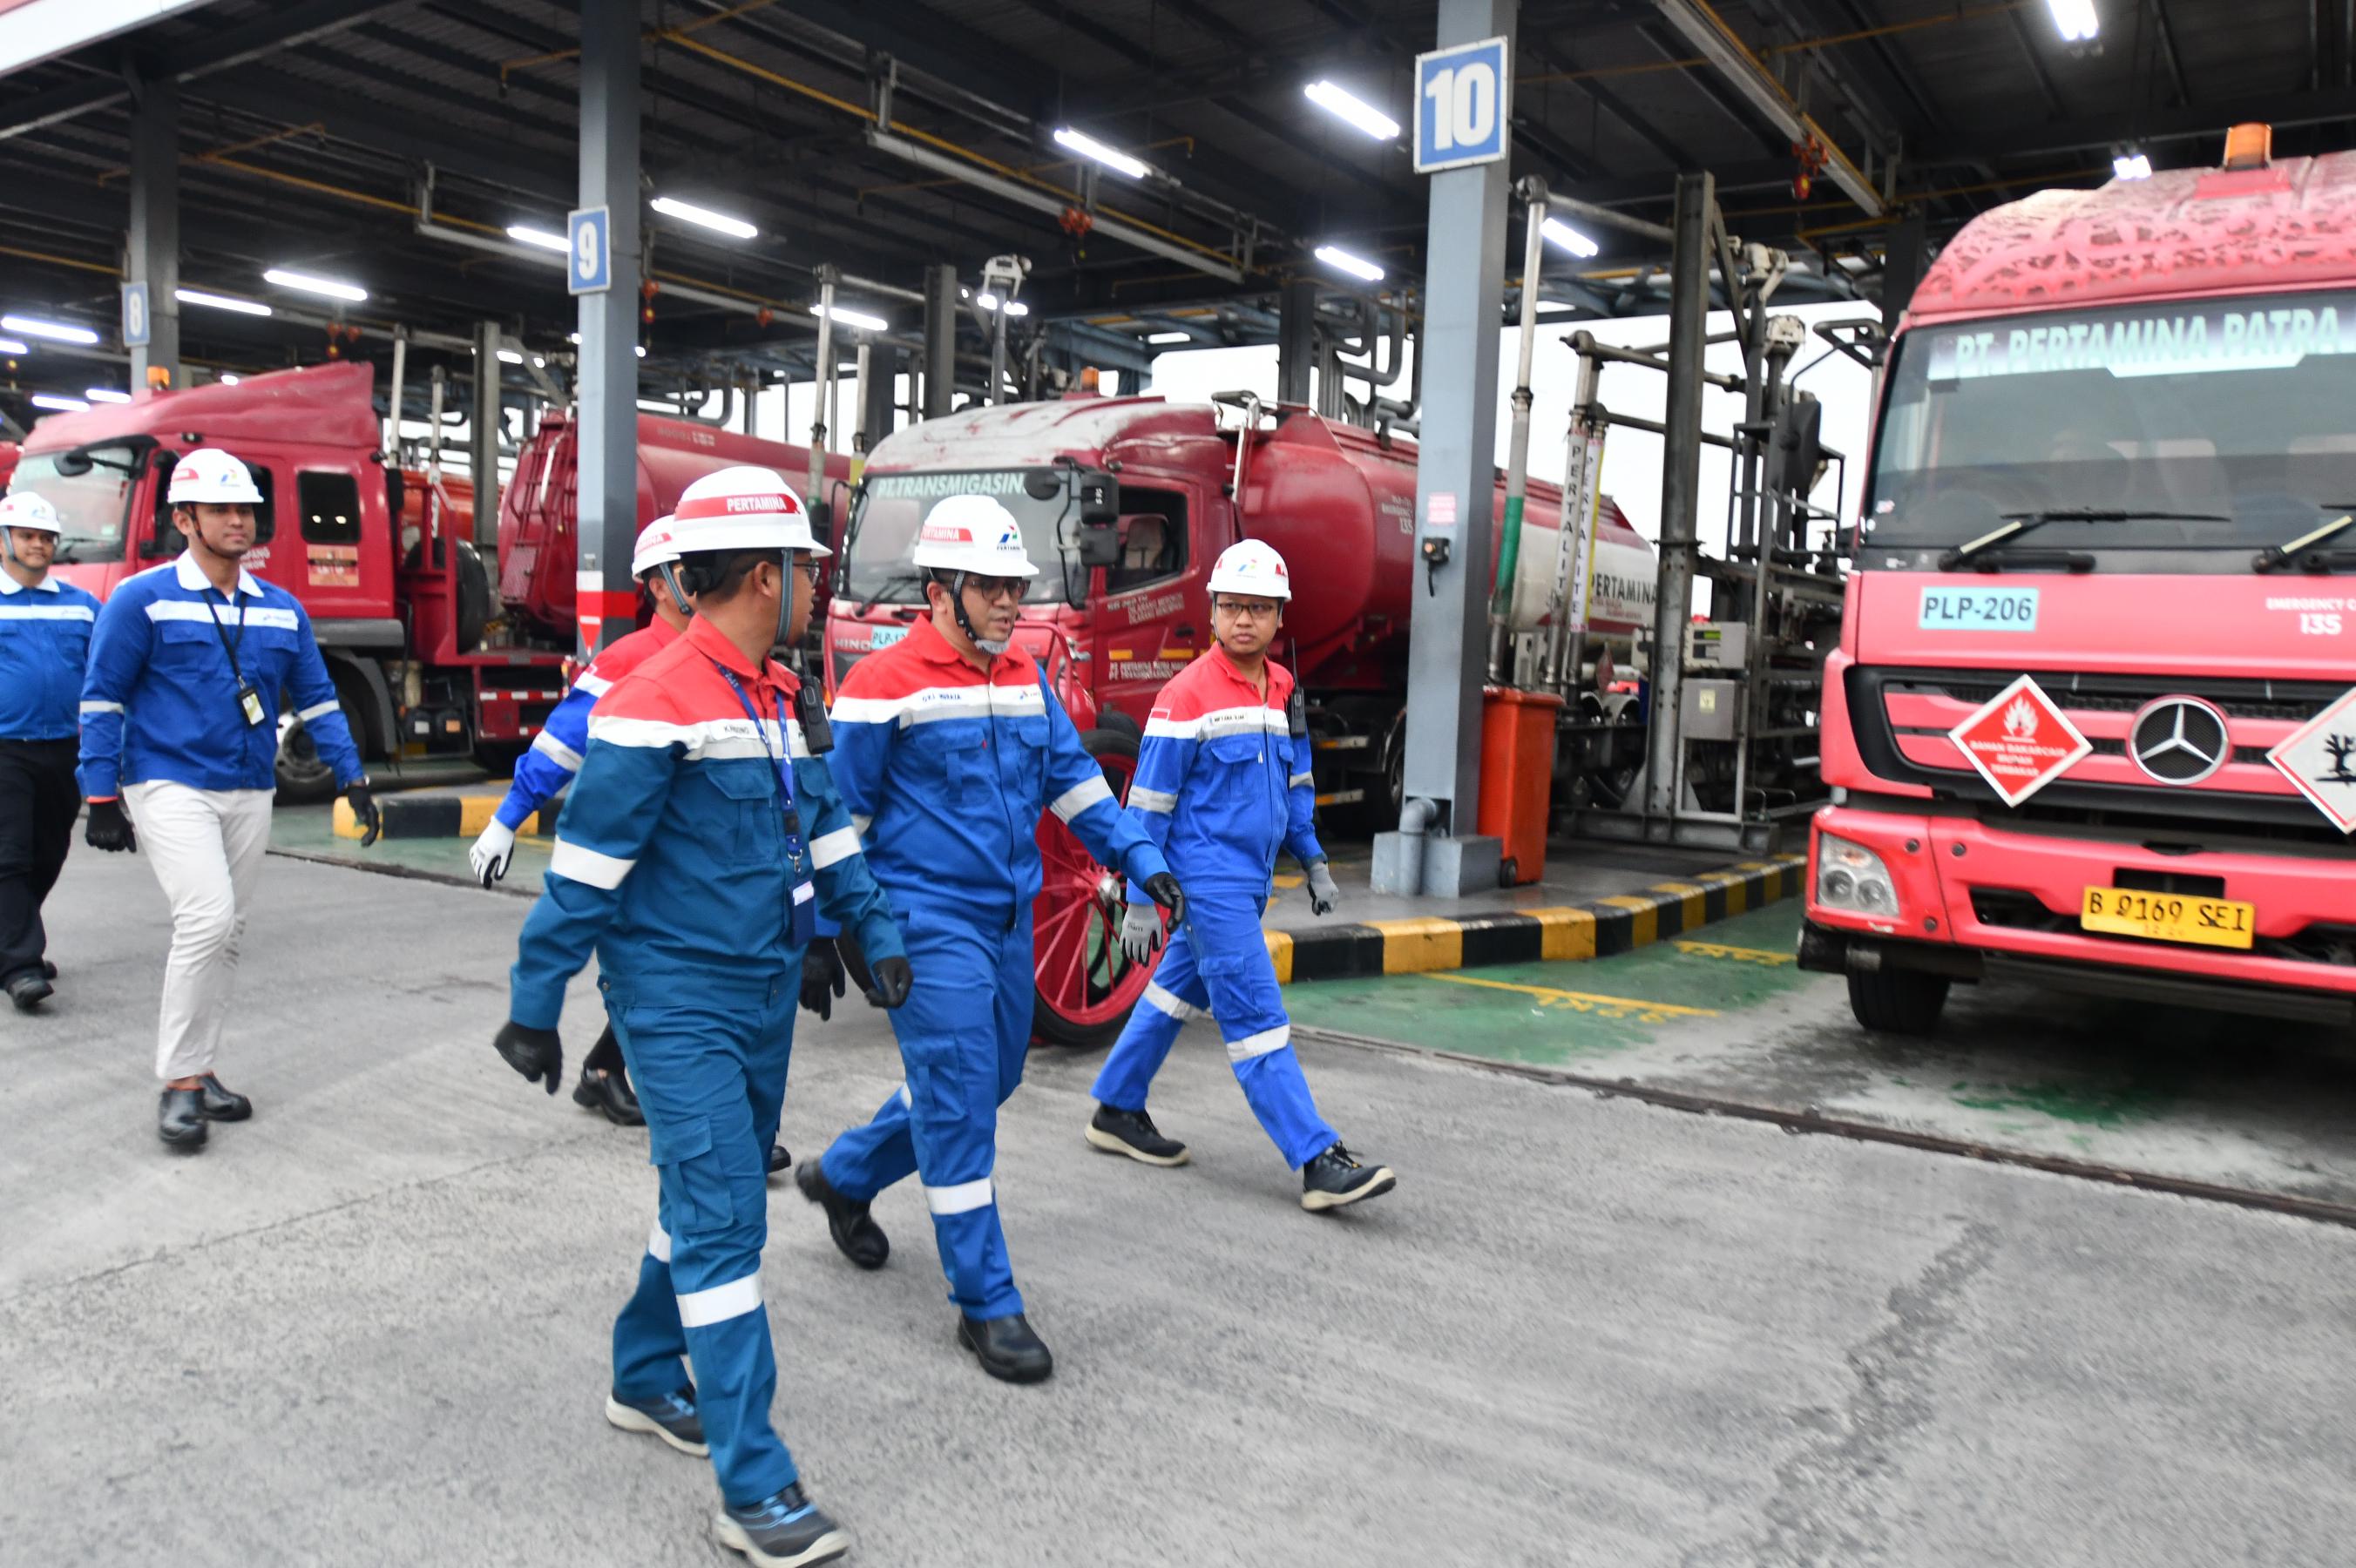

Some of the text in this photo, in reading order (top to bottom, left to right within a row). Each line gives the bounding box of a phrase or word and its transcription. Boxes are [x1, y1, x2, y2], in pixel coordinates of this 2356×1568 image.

[1425, 62, 1495, 151] 10
[578, 220, 598, 280] 9
[129, 291, 143, 337] 8
[2007, 315, 2208, 373] PERTAMINA
[2223, 307, 2342, 357] PATRA
[727, 495, 787, 512] PERTAMINA
[877, 473, 1027, 499] PT.TRANSMIGASIN
[1557, 446, 1582, 590] PERTALIT
[1924, 597, 2033, 621] PLP-206
[2300, 613, 2343, 635] 135
[836, 639, 871, 652] HINO
[2090, 892, 2102, 914] B
[2198, 904, 2245, 931] SEI
